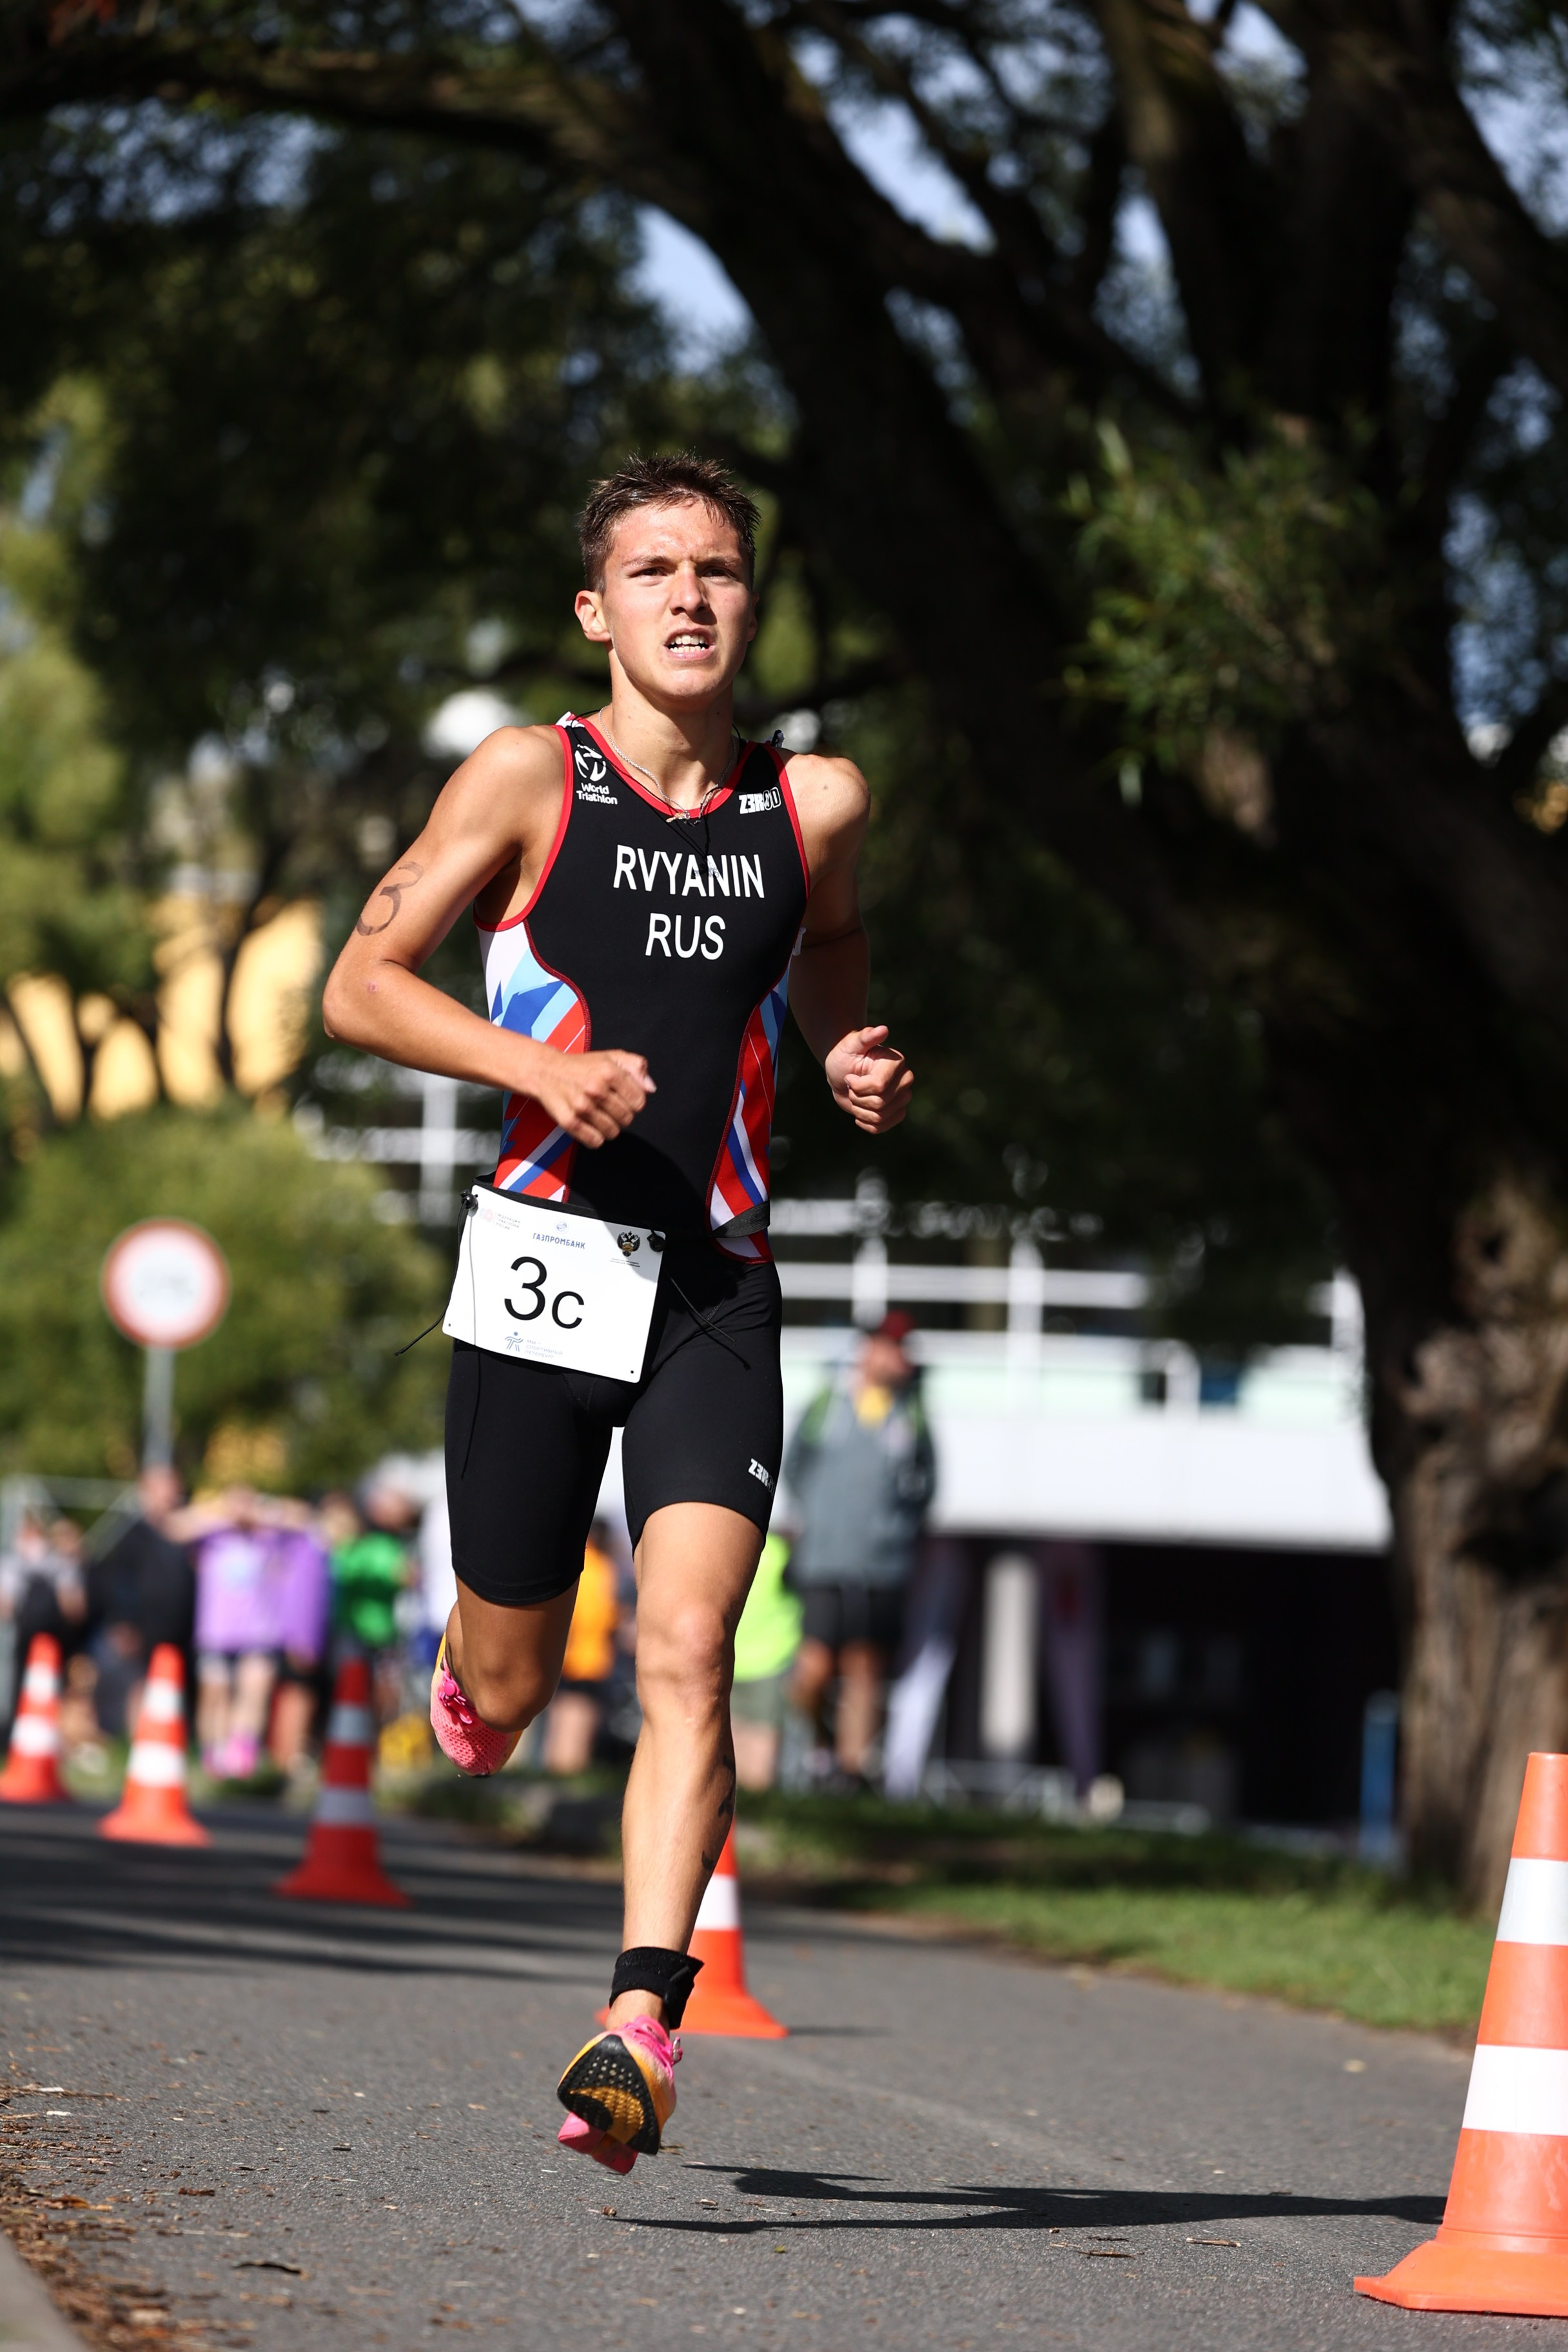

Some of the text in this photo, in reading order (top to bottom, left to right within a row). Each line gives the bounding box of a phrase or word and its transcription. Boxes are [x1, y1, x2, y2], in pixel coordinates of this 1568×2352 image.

[581, 782, 609, 794] World
[576, 790, 618, 805] Triathlon
[612, 844, 765, 899] RVYANIN
[645, 912, 726, 961] RUS
[533, 1233, 586, 1250] ГАЗПРОМБАНК
